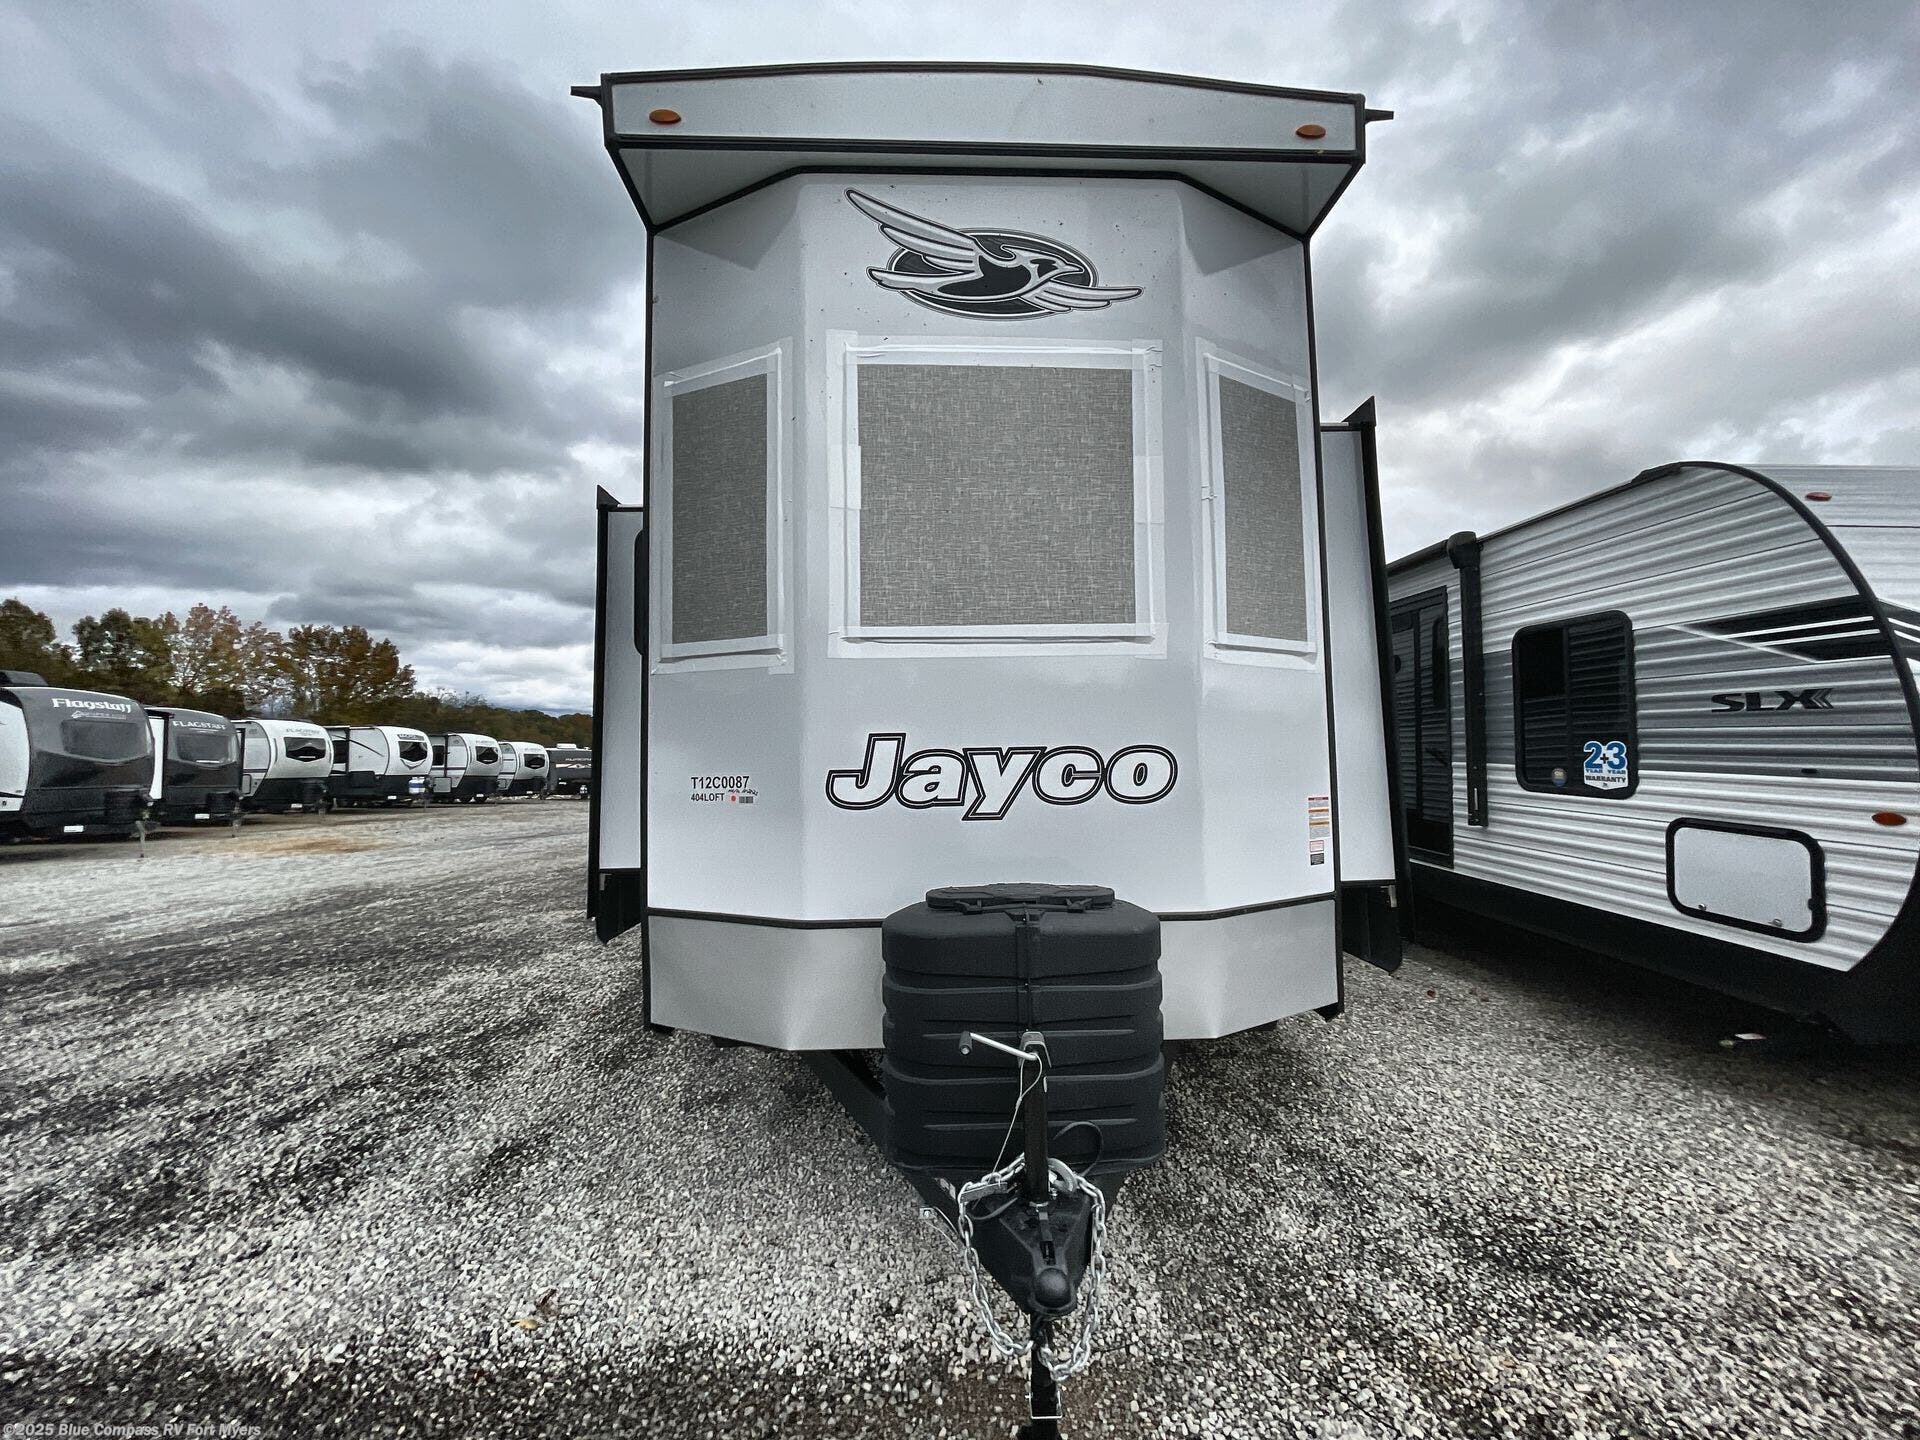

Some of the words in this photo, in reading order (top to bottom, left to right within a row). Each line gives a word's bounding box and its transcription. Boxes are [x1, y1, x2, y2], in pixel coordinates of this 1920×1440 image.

[51, 698, 131, 713] Flagstaff
[1711, 688, 1834, 712] SLX
[690, 775, 750, 789] T12C0087
[825, 732, 1179, 821] Jayco
[1585, 775, 1627, 783] WARRANTY
[690, 792, 726, 802] 404LOFT
